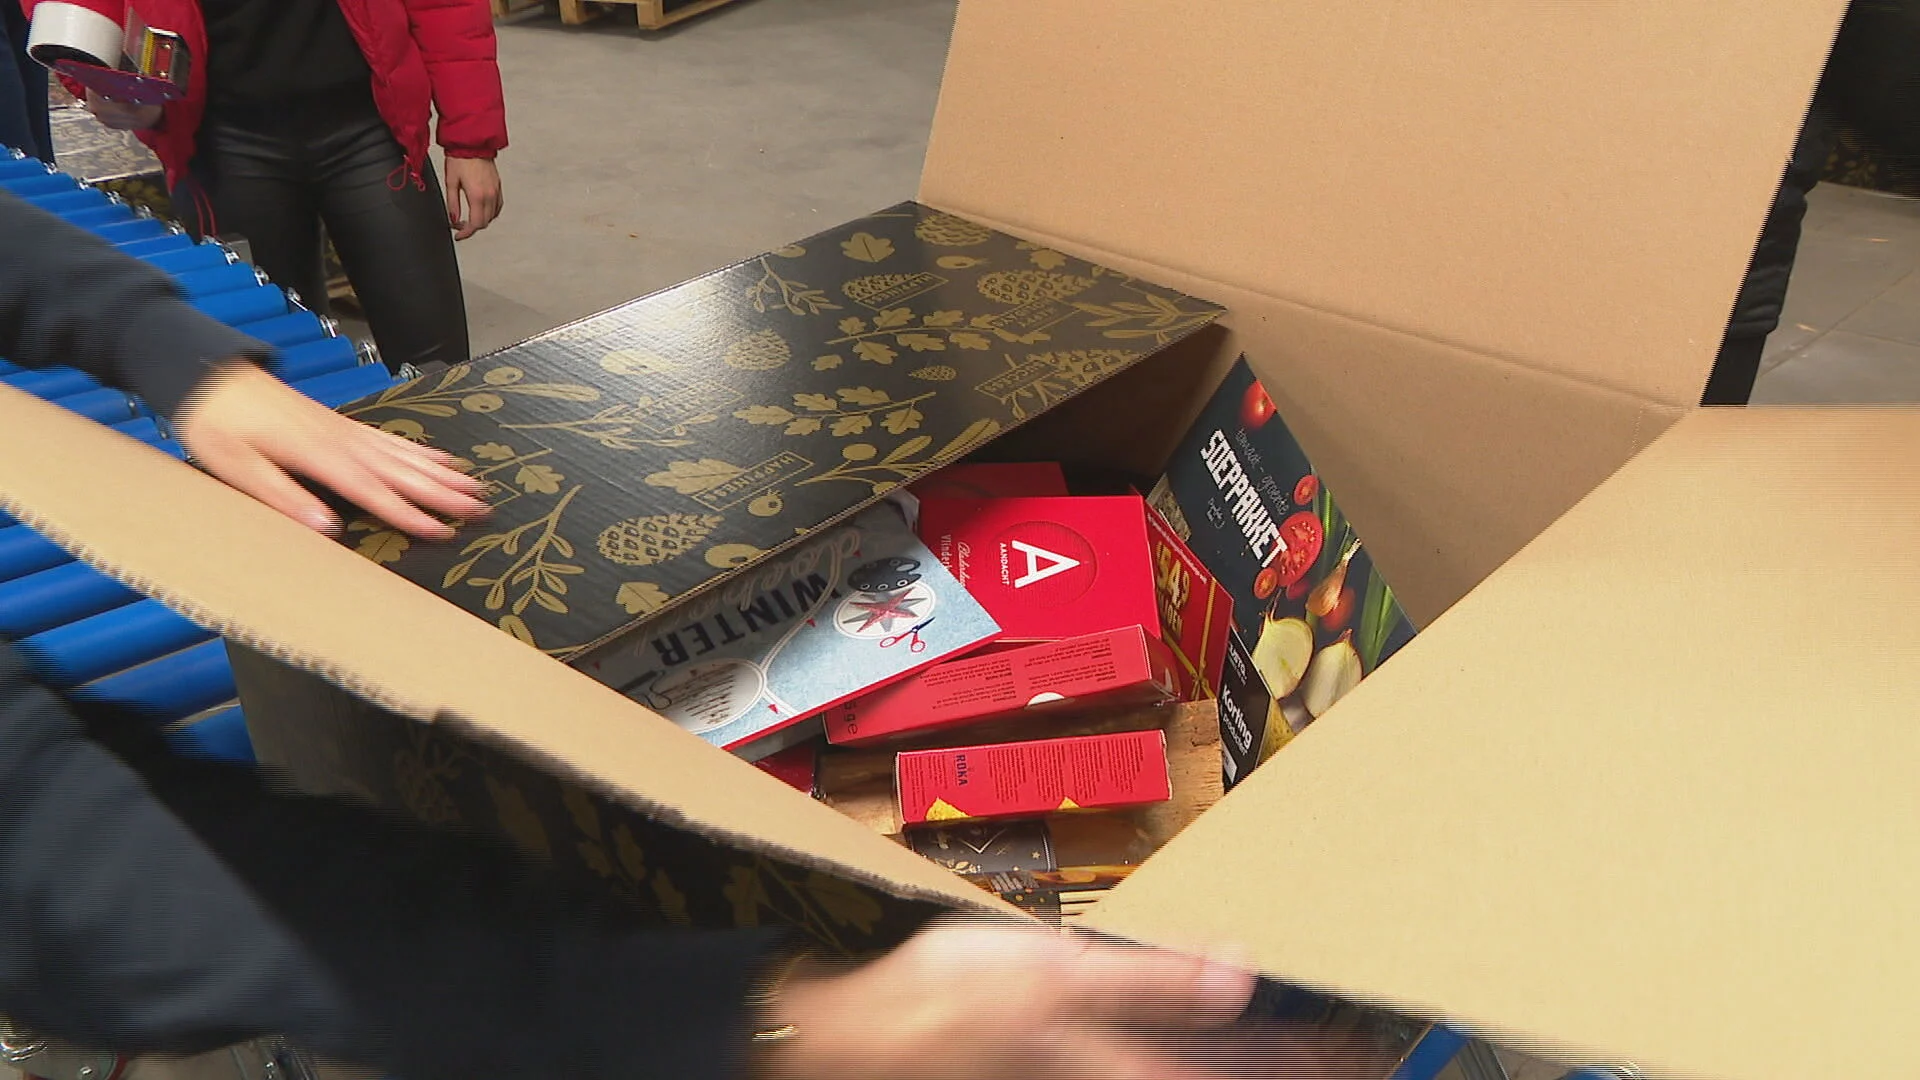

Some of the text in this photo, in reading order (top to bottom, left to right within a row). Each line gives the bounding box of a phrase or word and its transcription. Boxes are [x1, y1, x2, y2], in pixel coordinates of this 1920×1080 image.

[702, 454, 796, 501] HAPPINESS
[1200, 429, 1288, 568] SOEPPAKKET
[999, 542, 1011, 585] AANDACHT
[1011, 540, 1081, 589] A
[650, 573, 842, 669] WINTER
[1222, 684, 1254, 750] Korting
[954, 754, 969, 787] ROKA
